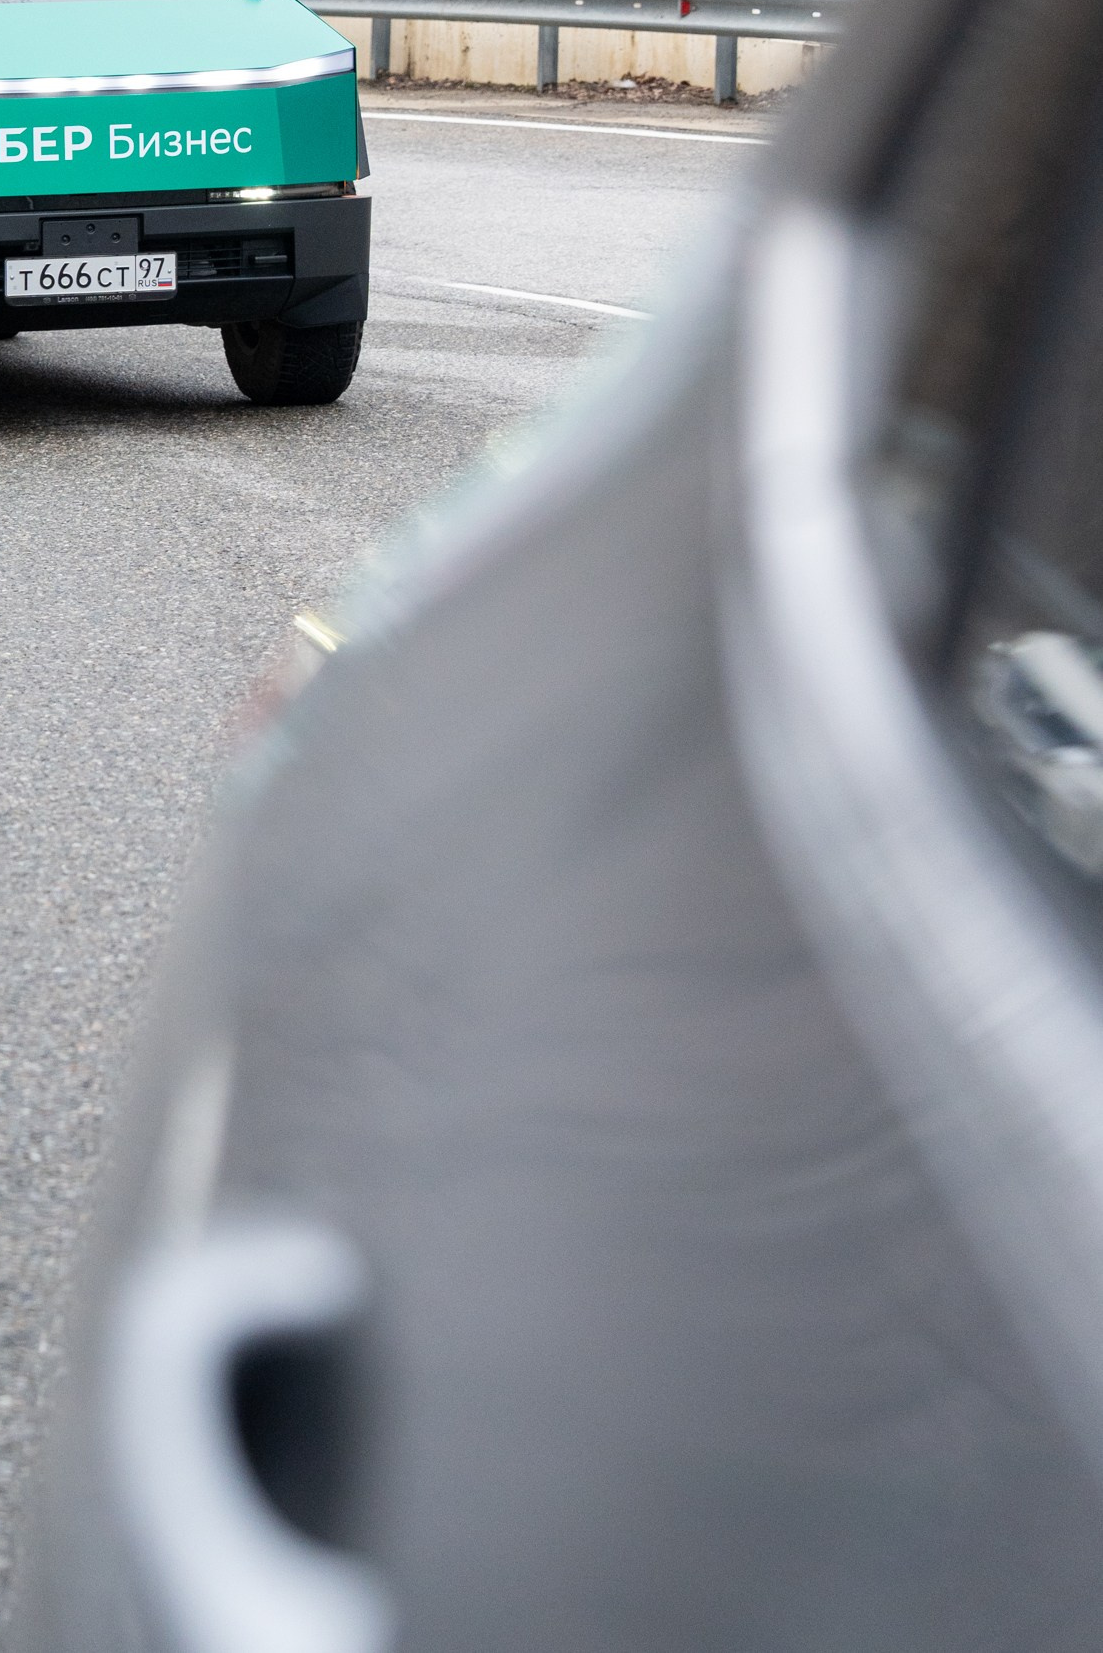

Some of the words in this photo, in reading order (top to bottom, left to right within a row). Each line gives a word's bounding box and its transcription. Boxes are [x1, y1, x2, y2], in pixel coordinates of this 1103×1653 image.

[109, 123, 252, 159] Бизнес
[139, 257, 165, 279] 97
[138, 279, 157, 287] RUS
